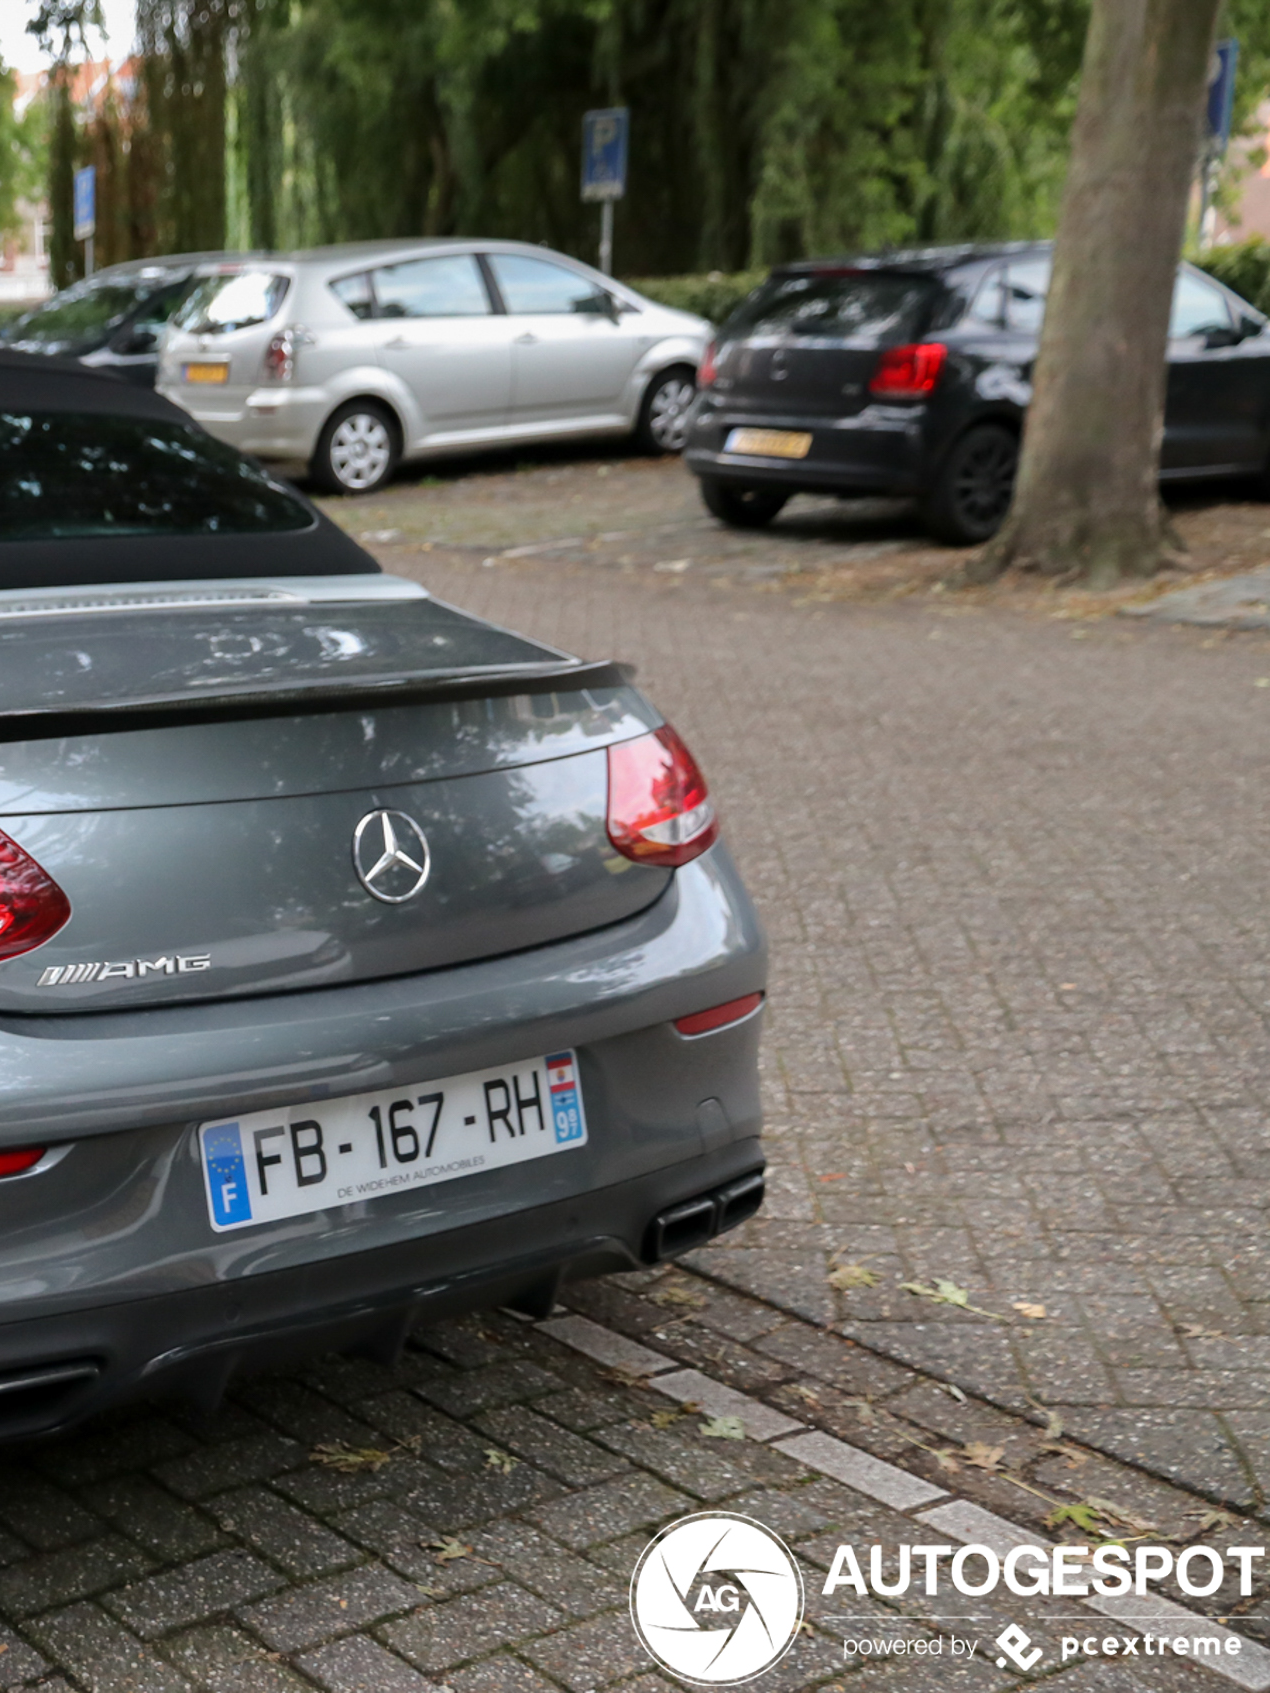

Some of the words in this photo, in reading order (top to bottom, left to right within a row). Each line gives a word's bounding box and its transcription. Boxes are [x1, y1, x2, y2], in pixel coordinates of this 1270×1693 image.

[593, 117, 616, 156] P
[96, 953, 211, 982] AMG
[337, 1186, 354, 1199] DE
[356, 1173, 411, 1194] WIDEHEM
[412, 1155, 486, 1181] AUTOMOBILES
[221, 1182, 238, 1214] F
